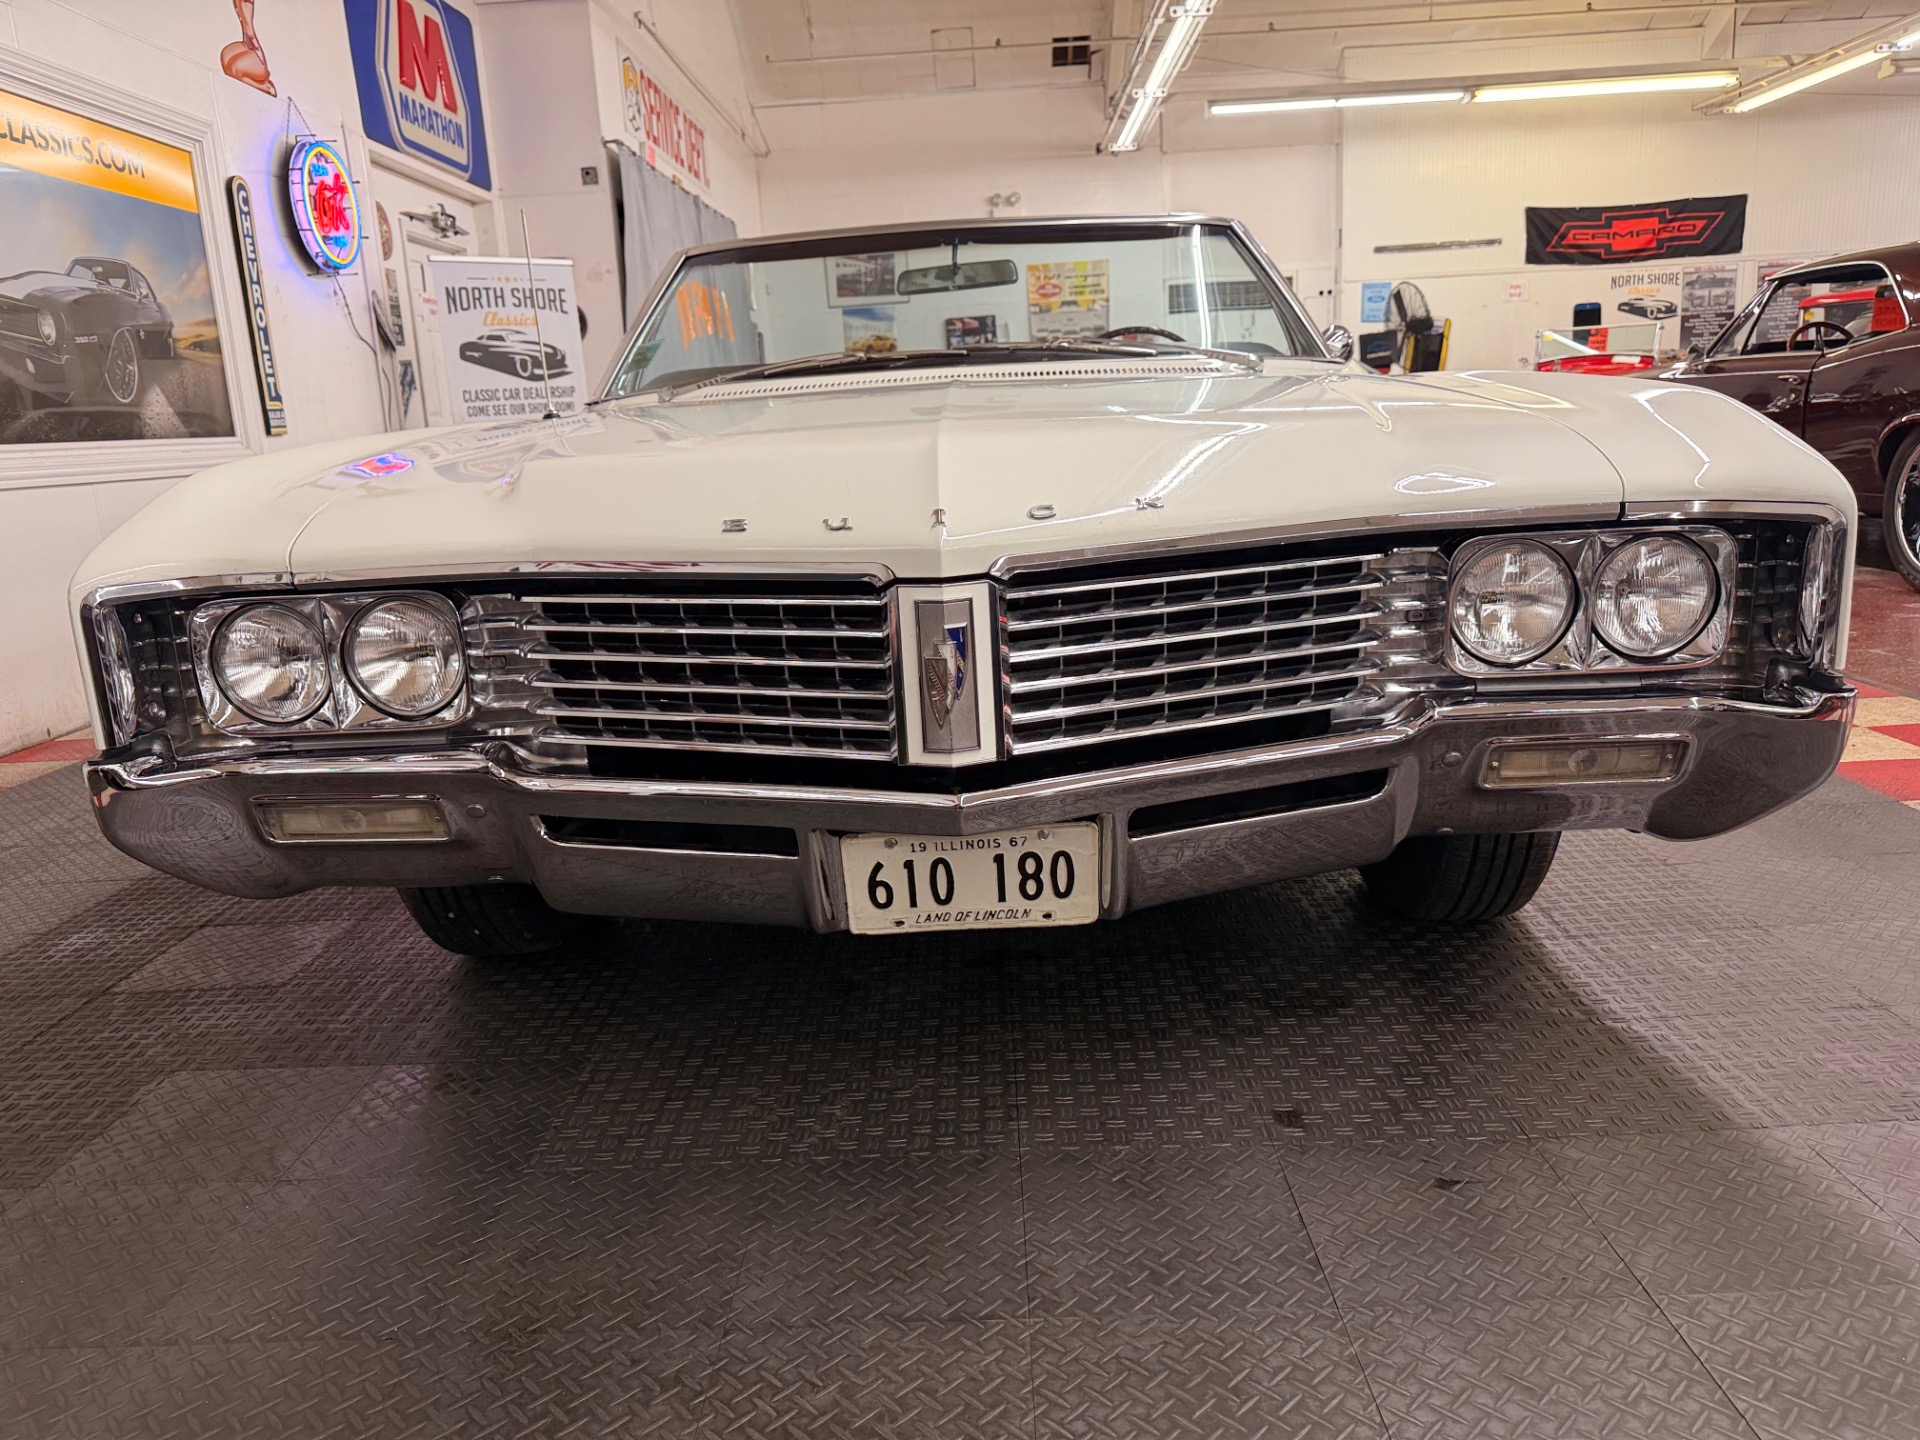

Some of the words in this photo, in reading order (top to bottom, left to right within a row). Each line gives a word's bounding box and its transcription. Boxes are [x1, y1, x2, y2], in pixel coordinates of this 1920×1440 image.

[399, 92, 465, 149] MARATHON
[639, 69, 685, 168] SERVICE
[1572, 222, 1698, 241] CAMARO
[1610, 274, 1644, 290] NORTH
[1646, 271, 1681, 287] SHORE
[237, 189, 278, 397] CHEVROLET
[444, 286, 506, 315] NORTH
[511, 286, 570, 315] SHORE
[462, 388, 501, 403] CLASSIC
[502, 388, 522, 402] CAR
[523, 386, 576, 401] DEALRSHIP
[466, 404, 492, 418] COME
[492, 403, 508, 416] SEE
[509, 403, 527, 415] OUR
[910, 842, 927, 853] 19
[935, 838, 1001, 852] ILLINOIS
[1009, 836, 1028, 847] 67
[867, 857, 955, 910] 610
[993, 850, 1075, 903] 180
[915, 911, 952, 924] LAND
[954, 910, 973, 922] OF
[974, 909, 1032, 921] LINCOLN
